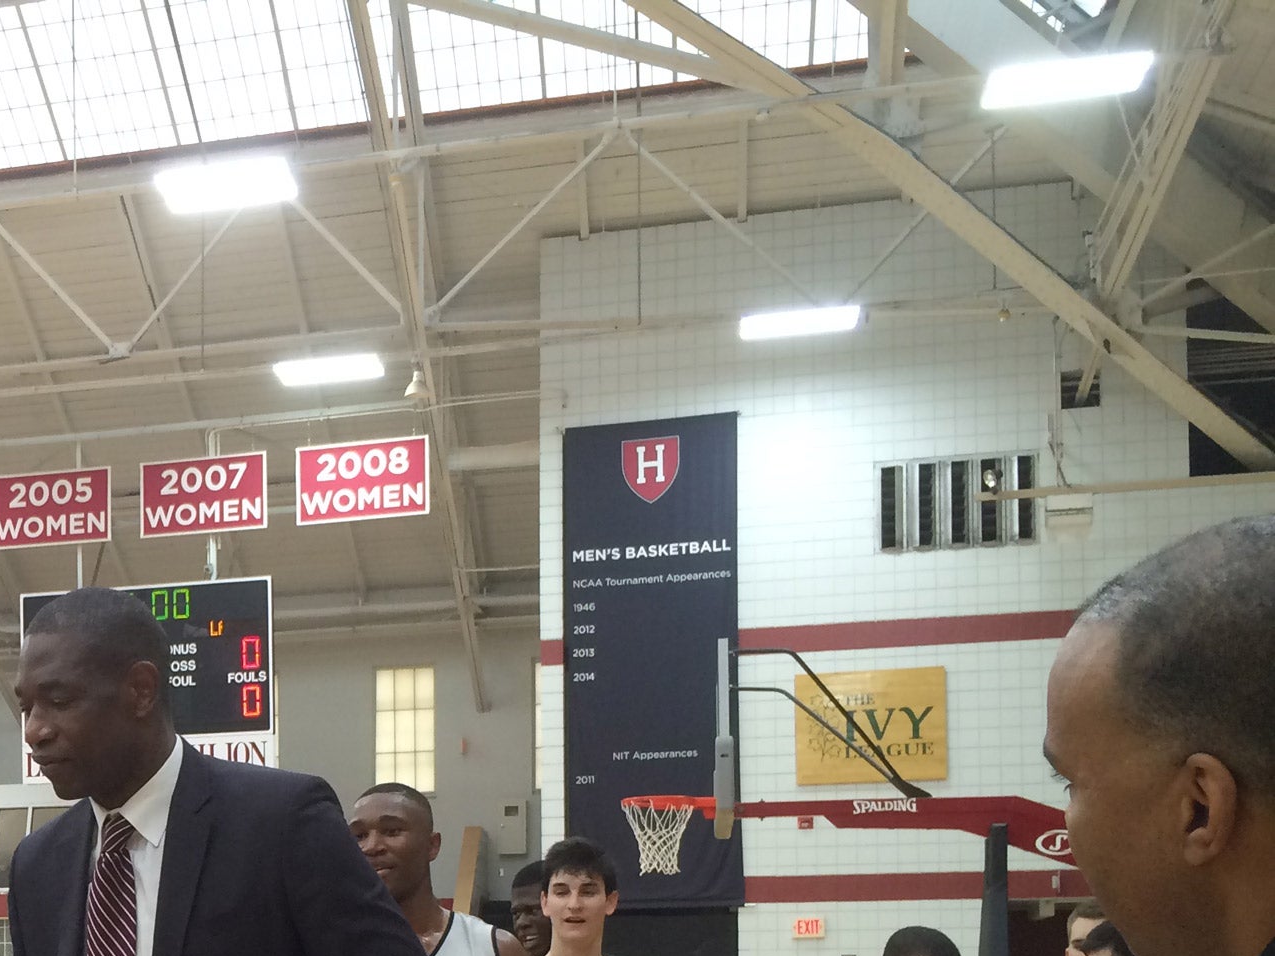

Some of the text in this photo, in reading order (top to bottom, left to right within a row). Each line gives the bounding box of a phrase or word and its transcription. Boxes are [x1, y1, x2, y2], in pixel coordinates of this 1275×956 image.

[317, 447, 409, 482] 2008
[636, 444, 665, 484] H
[161, 462, 247, 495] 2007
[9, 478, 92, 508] 2005
[302, 482, 423, 516] WOMEN
[146, 497, 261, 528] WOMEN
[573, 539, 731, 562] MEN'S BASKETBALL
[573, 570, 731, 588] NCAA Tournament Appearances
[574, 603, 595, 612] 1946
[574, 626, 595, 634] 2012
[573, 649, 595, 657] 2013
[171, 660, 196, 671] OSS
[228, 671, 266, 683] FOULS
[573, 673, 595, 681] 2014
[846, 706, 933, 743] IVY
[613, 750, 698, 760] NIT Appearances
[576, 776, 595, 784] 2011
[853, 798, 917, 814] SPALDING
[797, 919, 820, 934] EXIT
